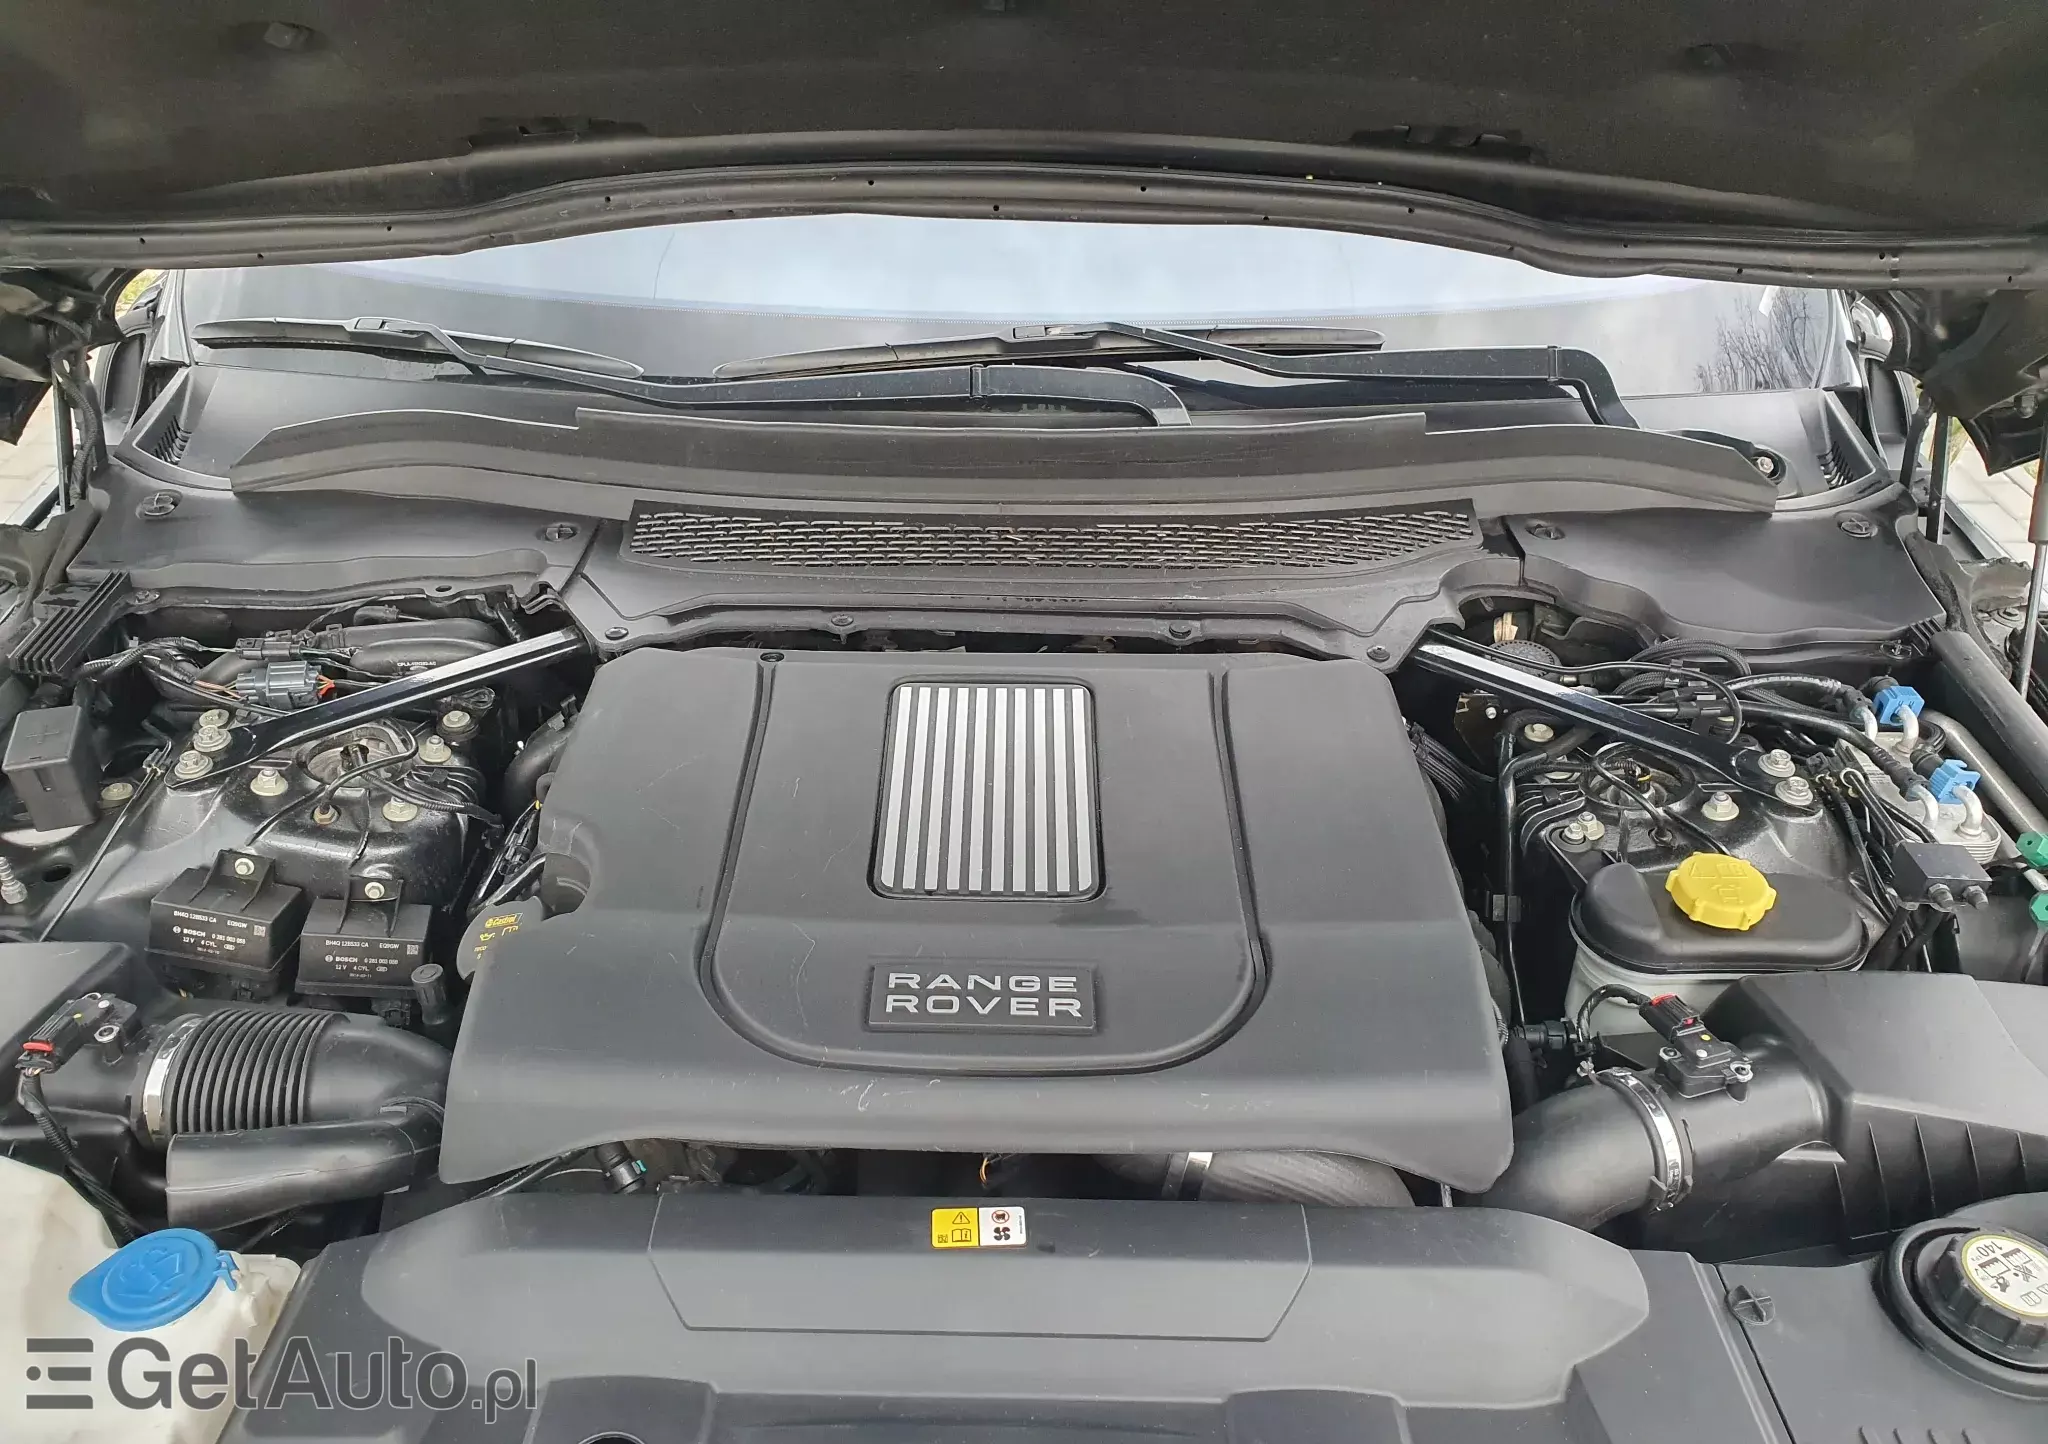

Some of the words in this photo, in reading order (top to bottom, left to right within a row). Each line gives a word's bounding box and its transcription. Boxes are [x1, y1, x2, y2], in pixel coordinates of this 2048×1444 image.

[183, 928, 206, 937] BOSCH
[888, 972, 1077, 992] RANGE
[885, 994, 1083, 1018] ROVER
[1976, 1240, 2003, 1257] 140
